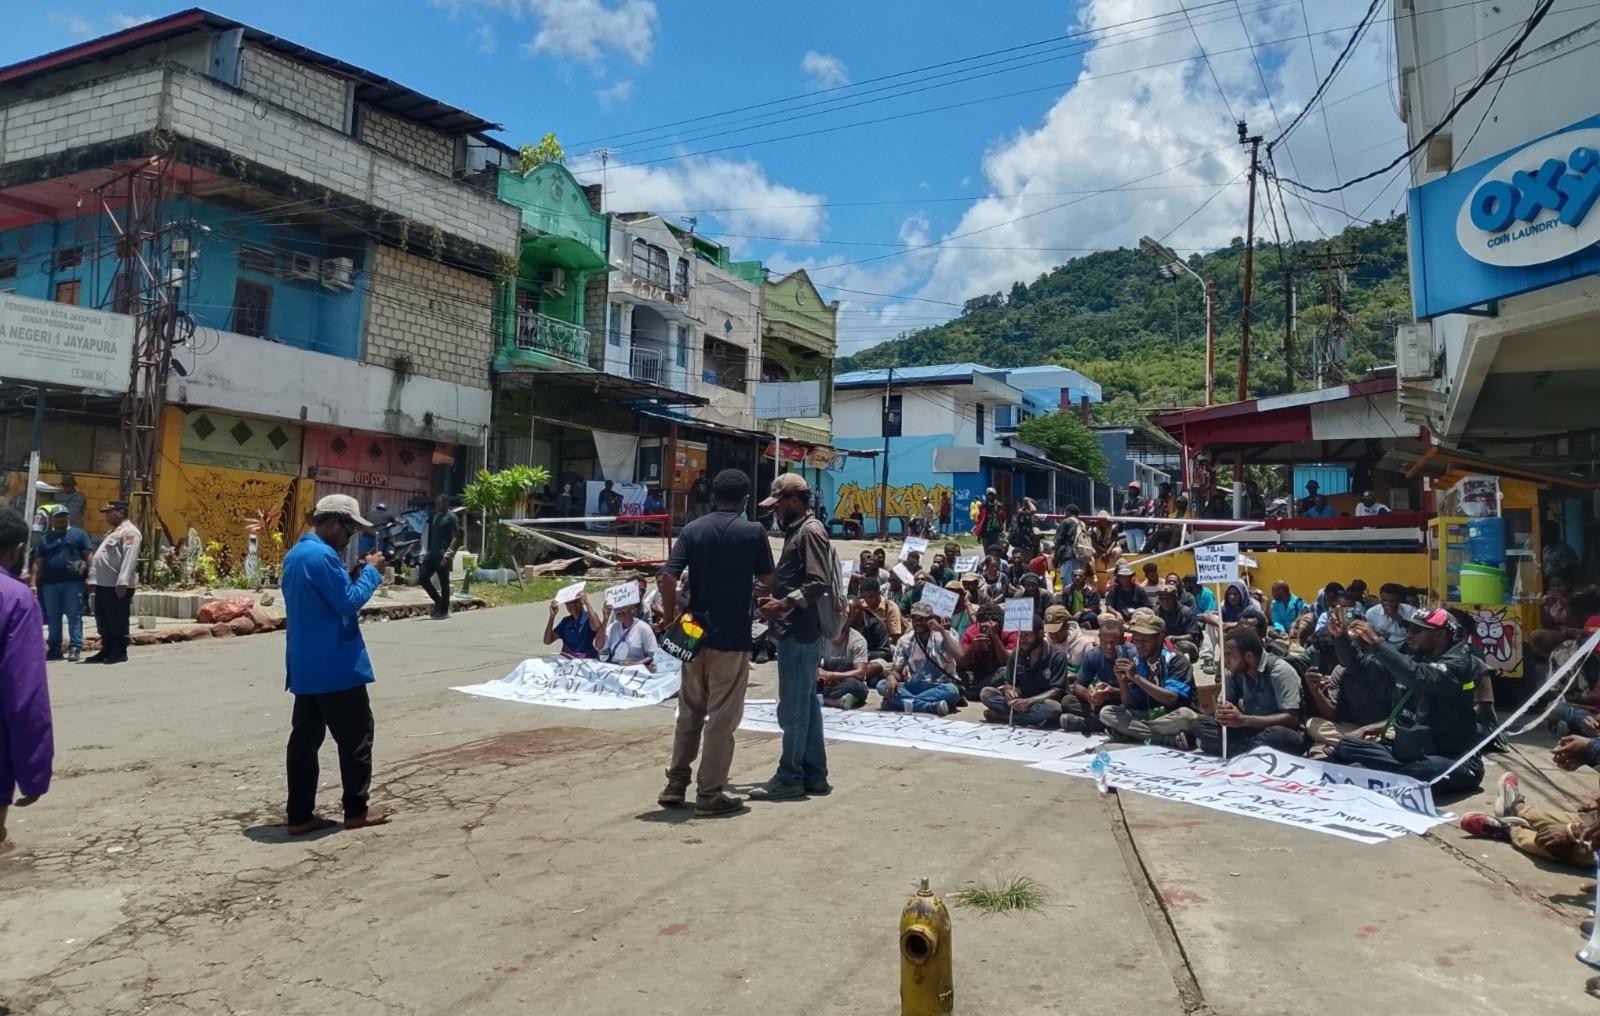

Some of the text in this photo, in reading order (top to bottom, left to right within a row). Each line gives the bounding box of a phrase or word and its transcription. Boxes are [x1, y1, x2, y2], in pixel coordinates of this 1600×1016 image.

[1486, 219, 1560, 248] COIN LAUNDRY
[44, 318, 85, 332] PENDIDIKAN
[50, 310, 68, 320] KOTA
[69, 313, 102, 326] JAYAPURA
[9, 325, 51, 344] NEGERI
[55, 333, 60, 346] 1
[63, 335, 118, 355] JAYAPURA
[661, 637, 692, 661] PAPUA
[1217, 790, 1330, 814] CABUT
